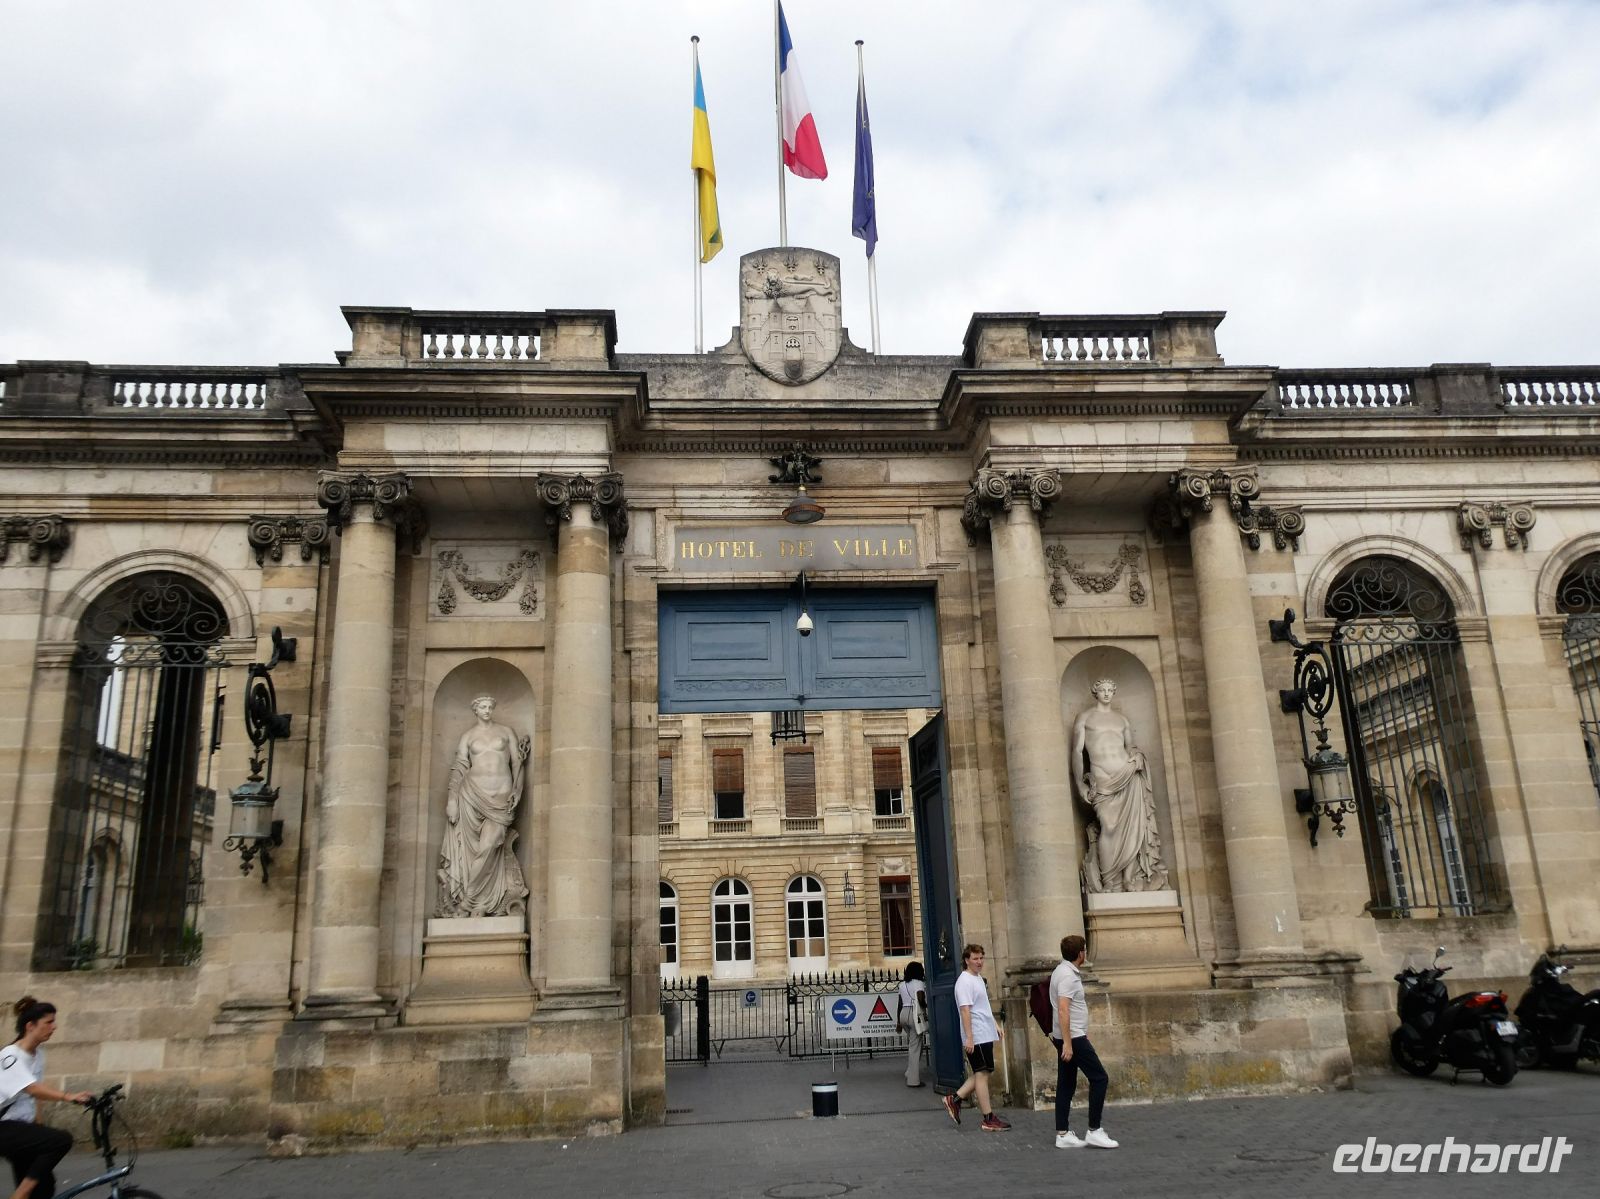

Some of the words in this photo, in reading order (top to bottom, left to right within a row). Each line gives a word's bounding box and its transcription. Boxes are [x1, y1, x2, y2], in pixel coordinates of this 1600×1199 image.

[681, 541, 762, 558] HOTEL
[779, 540, 813, 558] DE
[833, 538, 912, 556] VILLE
